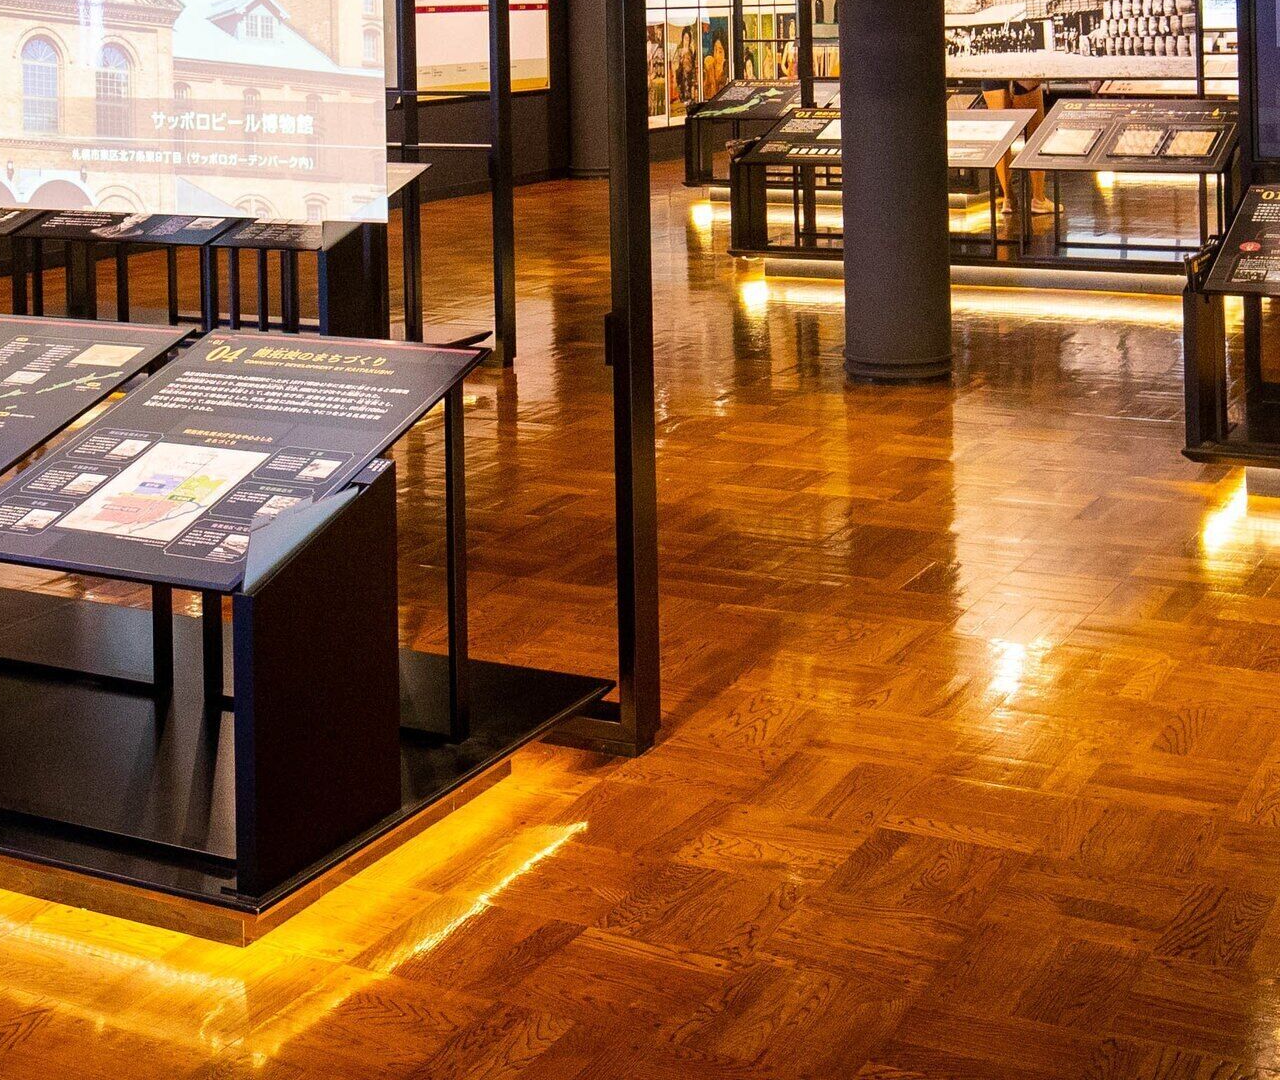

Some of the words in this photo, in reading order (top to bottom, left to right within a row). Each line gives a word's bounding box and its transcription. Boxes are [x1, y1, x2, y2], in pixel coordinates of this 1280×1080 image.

[151, 112, 314, 135] サッポロビール博物館
[205, 345, 248, 363] 04
[252, 347, 387, 367] 開拓使のまちづくり
